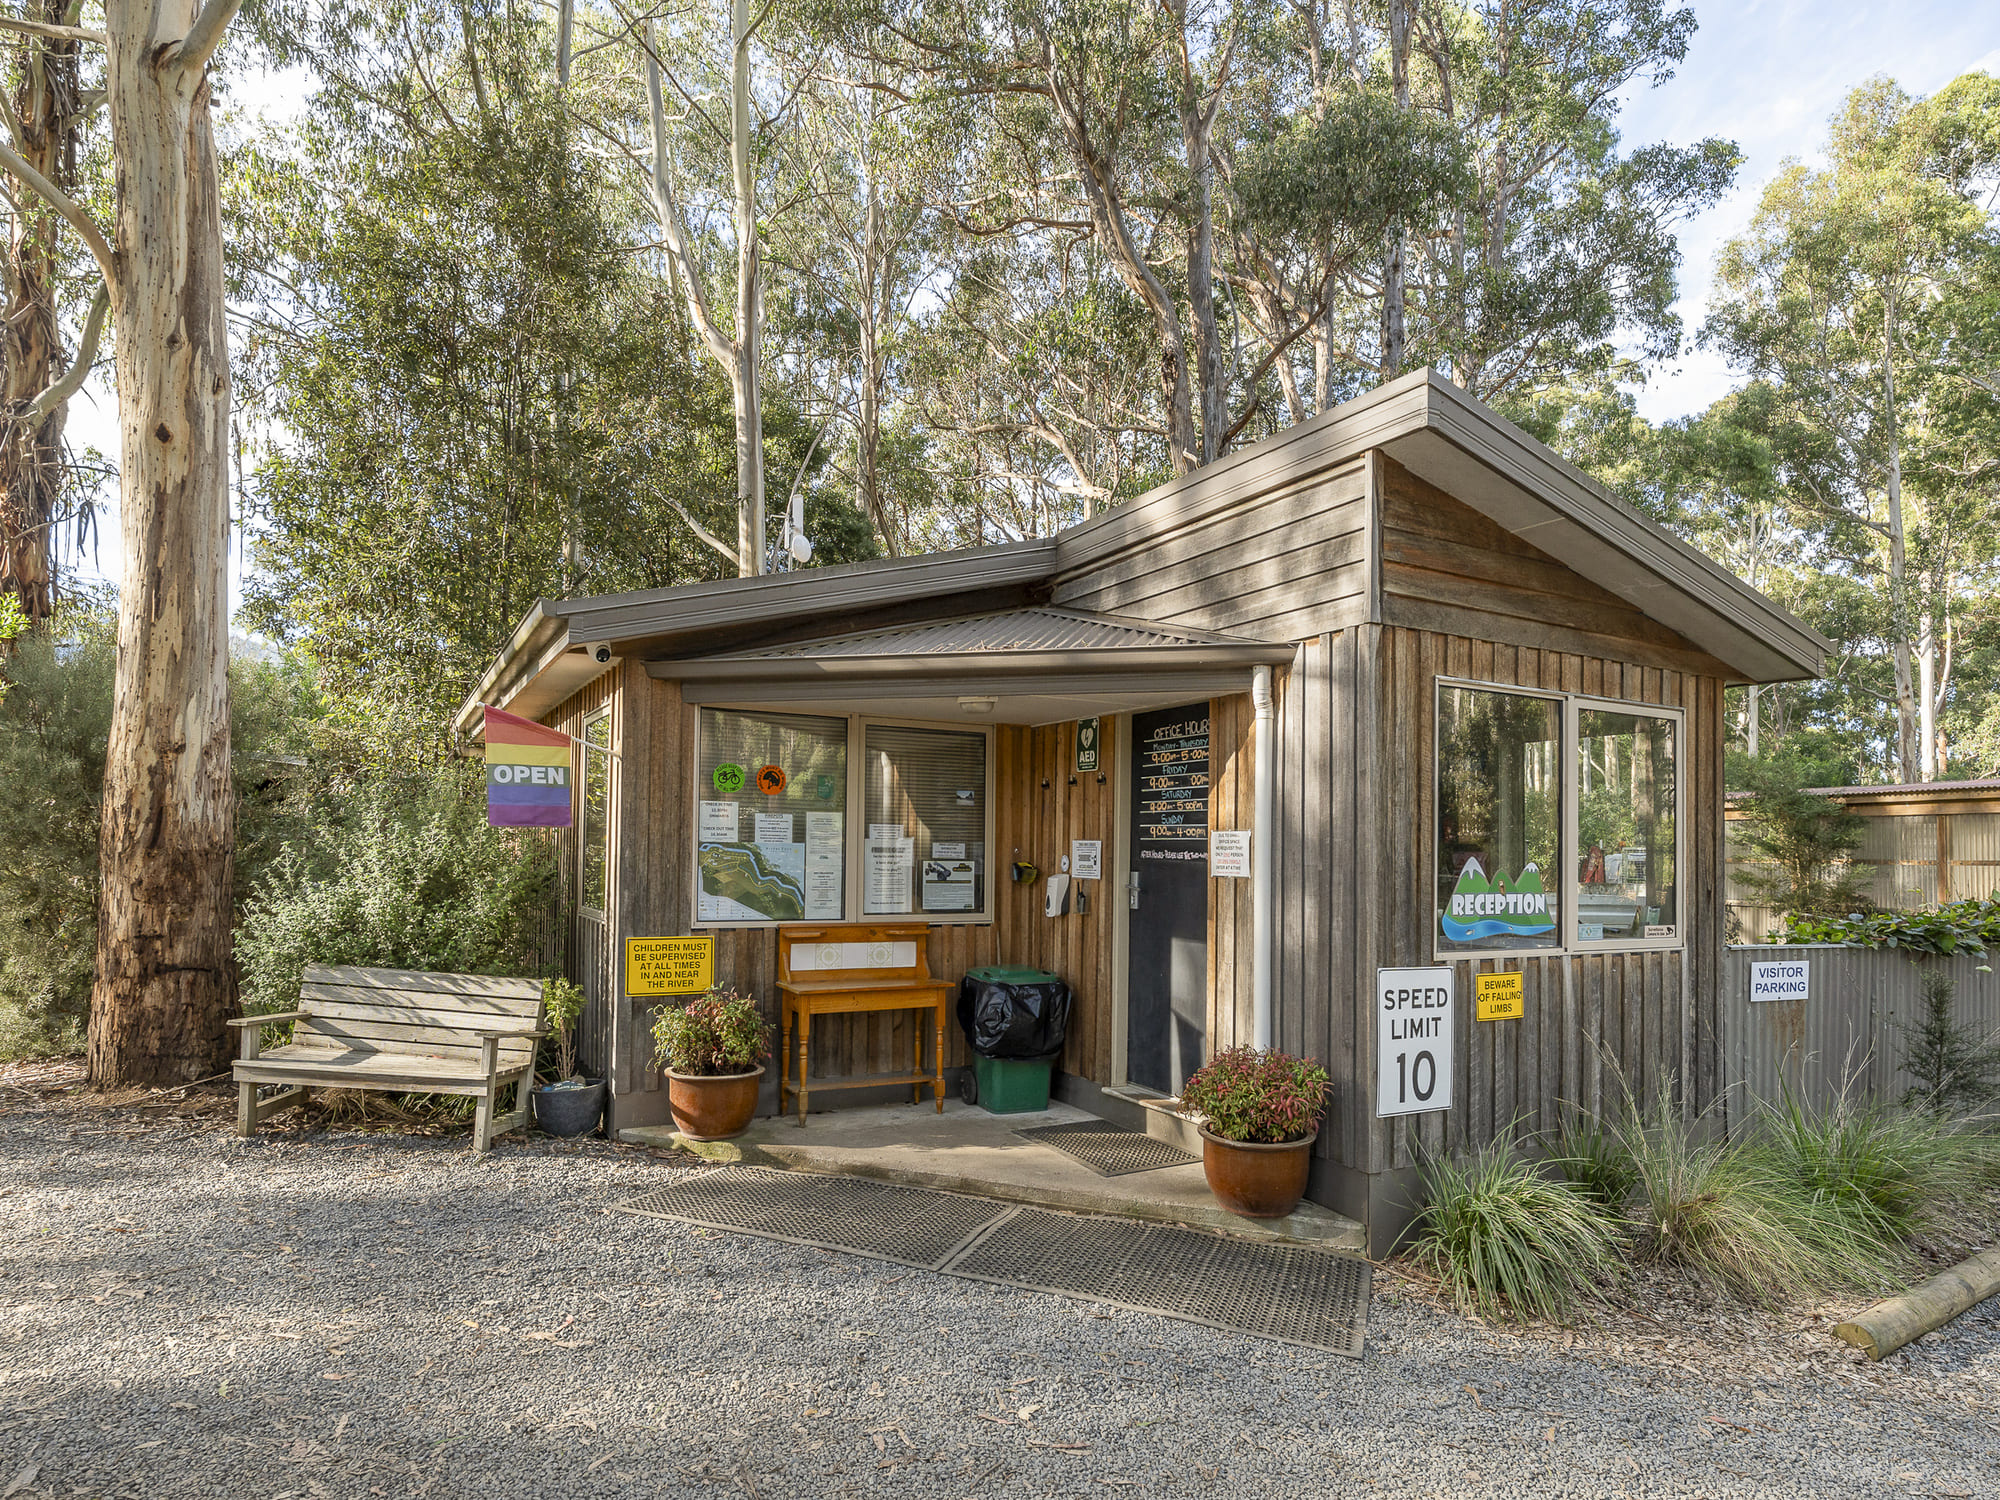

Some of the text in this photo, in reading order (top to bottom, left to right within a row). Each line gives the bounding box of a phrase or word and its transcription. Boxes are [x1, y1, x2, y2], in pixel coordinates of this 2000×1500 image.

[1080, 751, 1095, 762] AED
[1162, 764, 1188, 774] FRIDAY
[494, 765, 564, 785] OPEN
[1161, 790, 1192, 799] SATURDAY
[1161, 814, 1184, 824] SUNDAY
[1452, 893, 1545, 916] RECEPTION
[634, 943, 707, 952] CHILDREN MUST
[649, 952, 705, 961] SUPERVISED
[654, 962, 671, 970] ALL
[674, 961, 701, 969] TIMES
[653, 971, 672, 979] AND
[675, 970, 699, 978] NEAR
[1758, 967, 1803, 978] VISITOR
[1484, 979, 1516, 990] BEWARE
[1755, 981, 1806, 993] PARKING
[1384, 987, 1448, 1010] SPEED
[1479, 991, 1521, 1002] OF FALLING
[1490, 1003, 1512, 1013] LIMBS
[1391, 1016, 1442, 1040] LIMIT
[1396, 1050, 1436, 1103] 10
